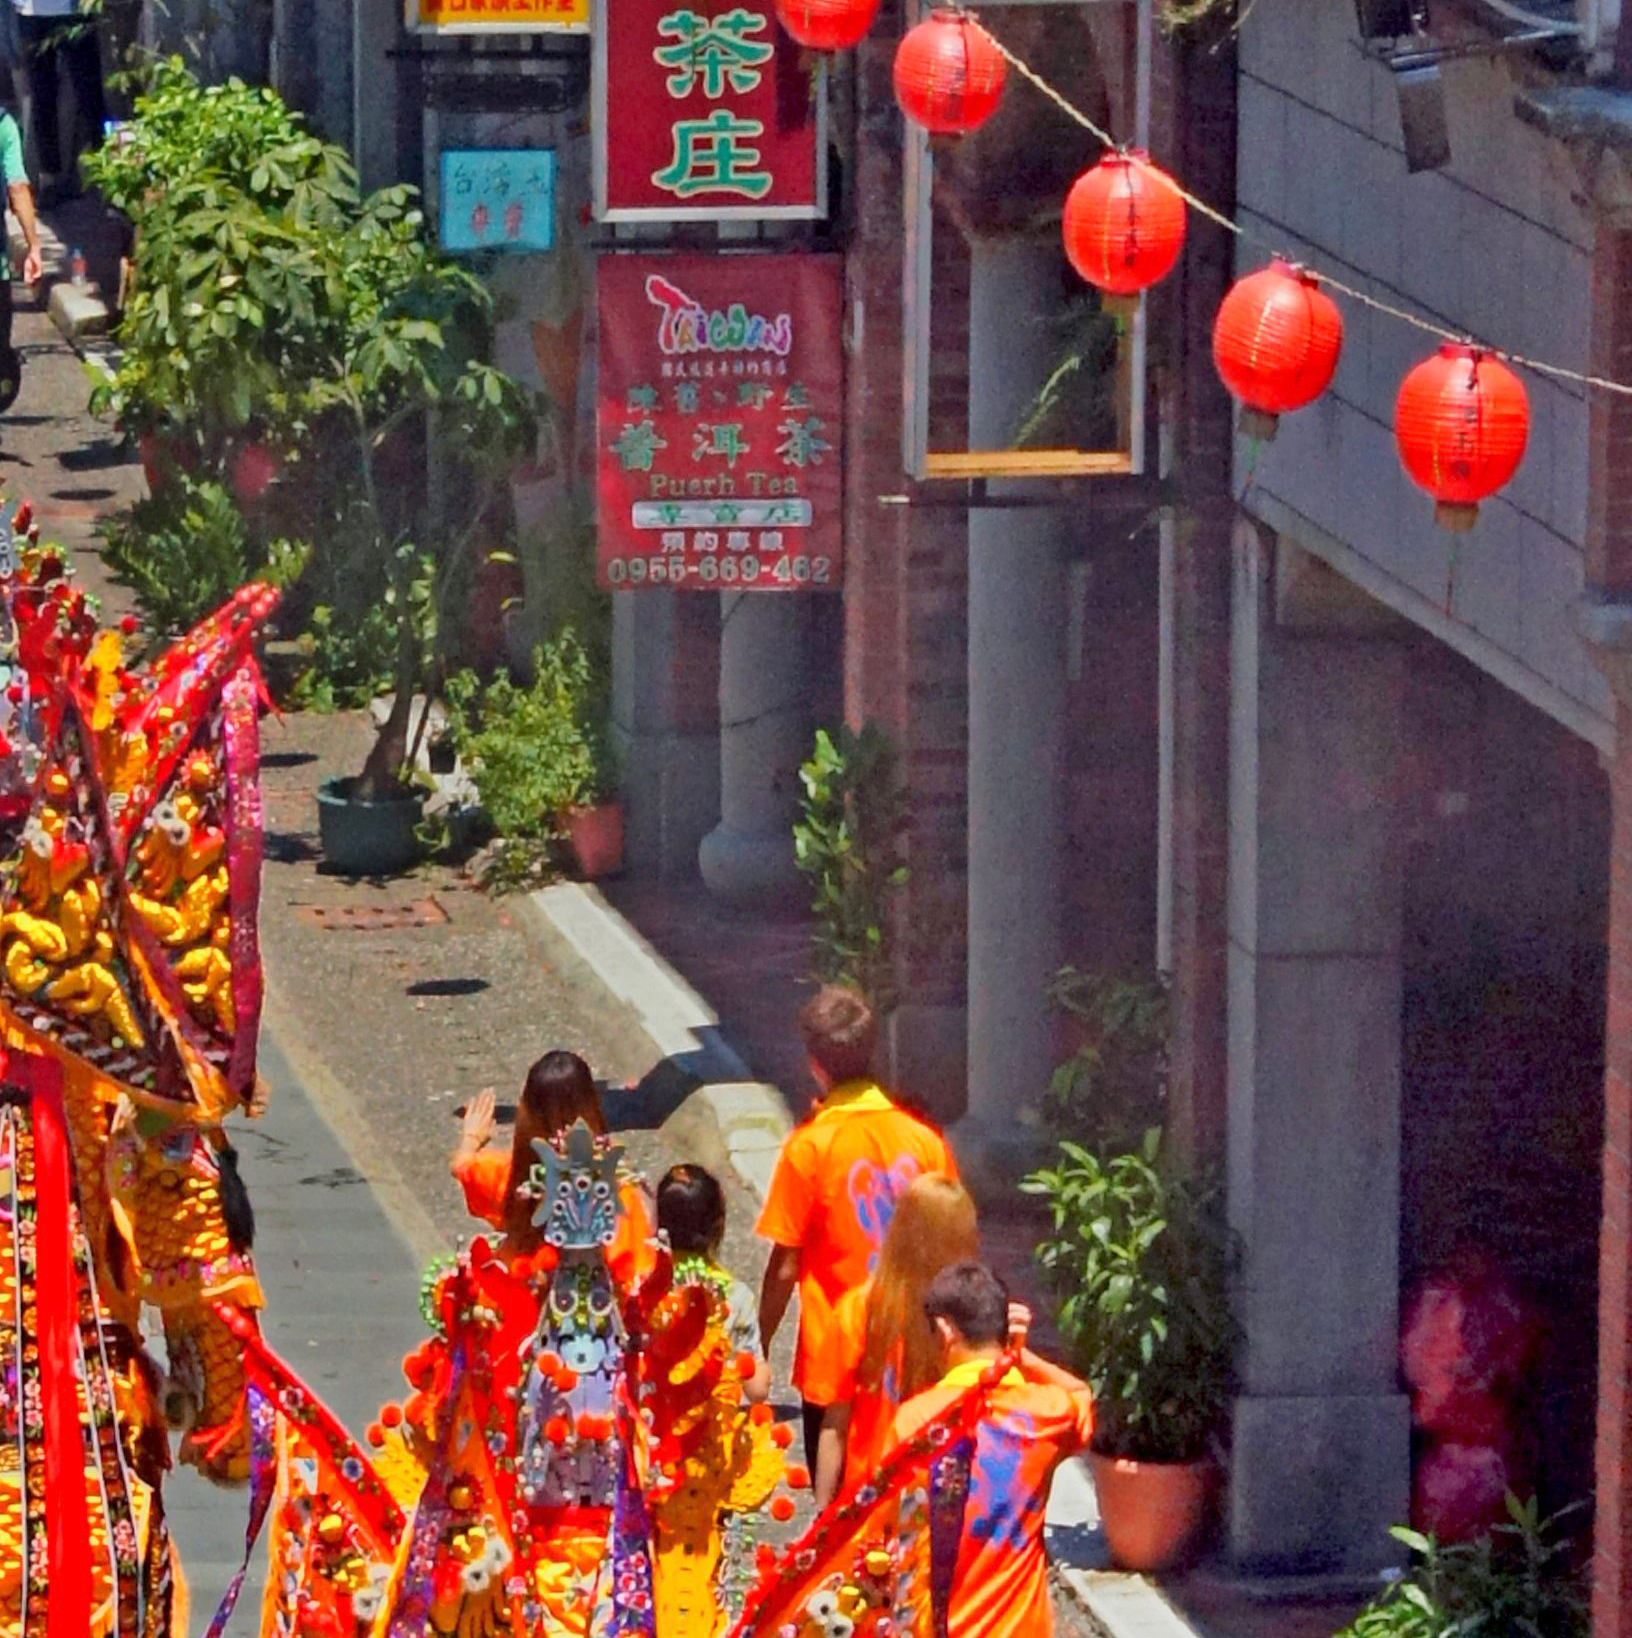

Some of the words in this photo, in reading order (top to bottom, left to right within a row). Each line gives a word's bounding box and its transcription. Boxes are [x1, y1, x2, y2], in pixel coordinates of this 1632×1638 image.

[608, 416, 833, 472] 普洱茶
[649, 474, 736, 497] Puerh
[746, 472, 799, 496] Tea
[607, 555, 831, 584] 0955-669-462
